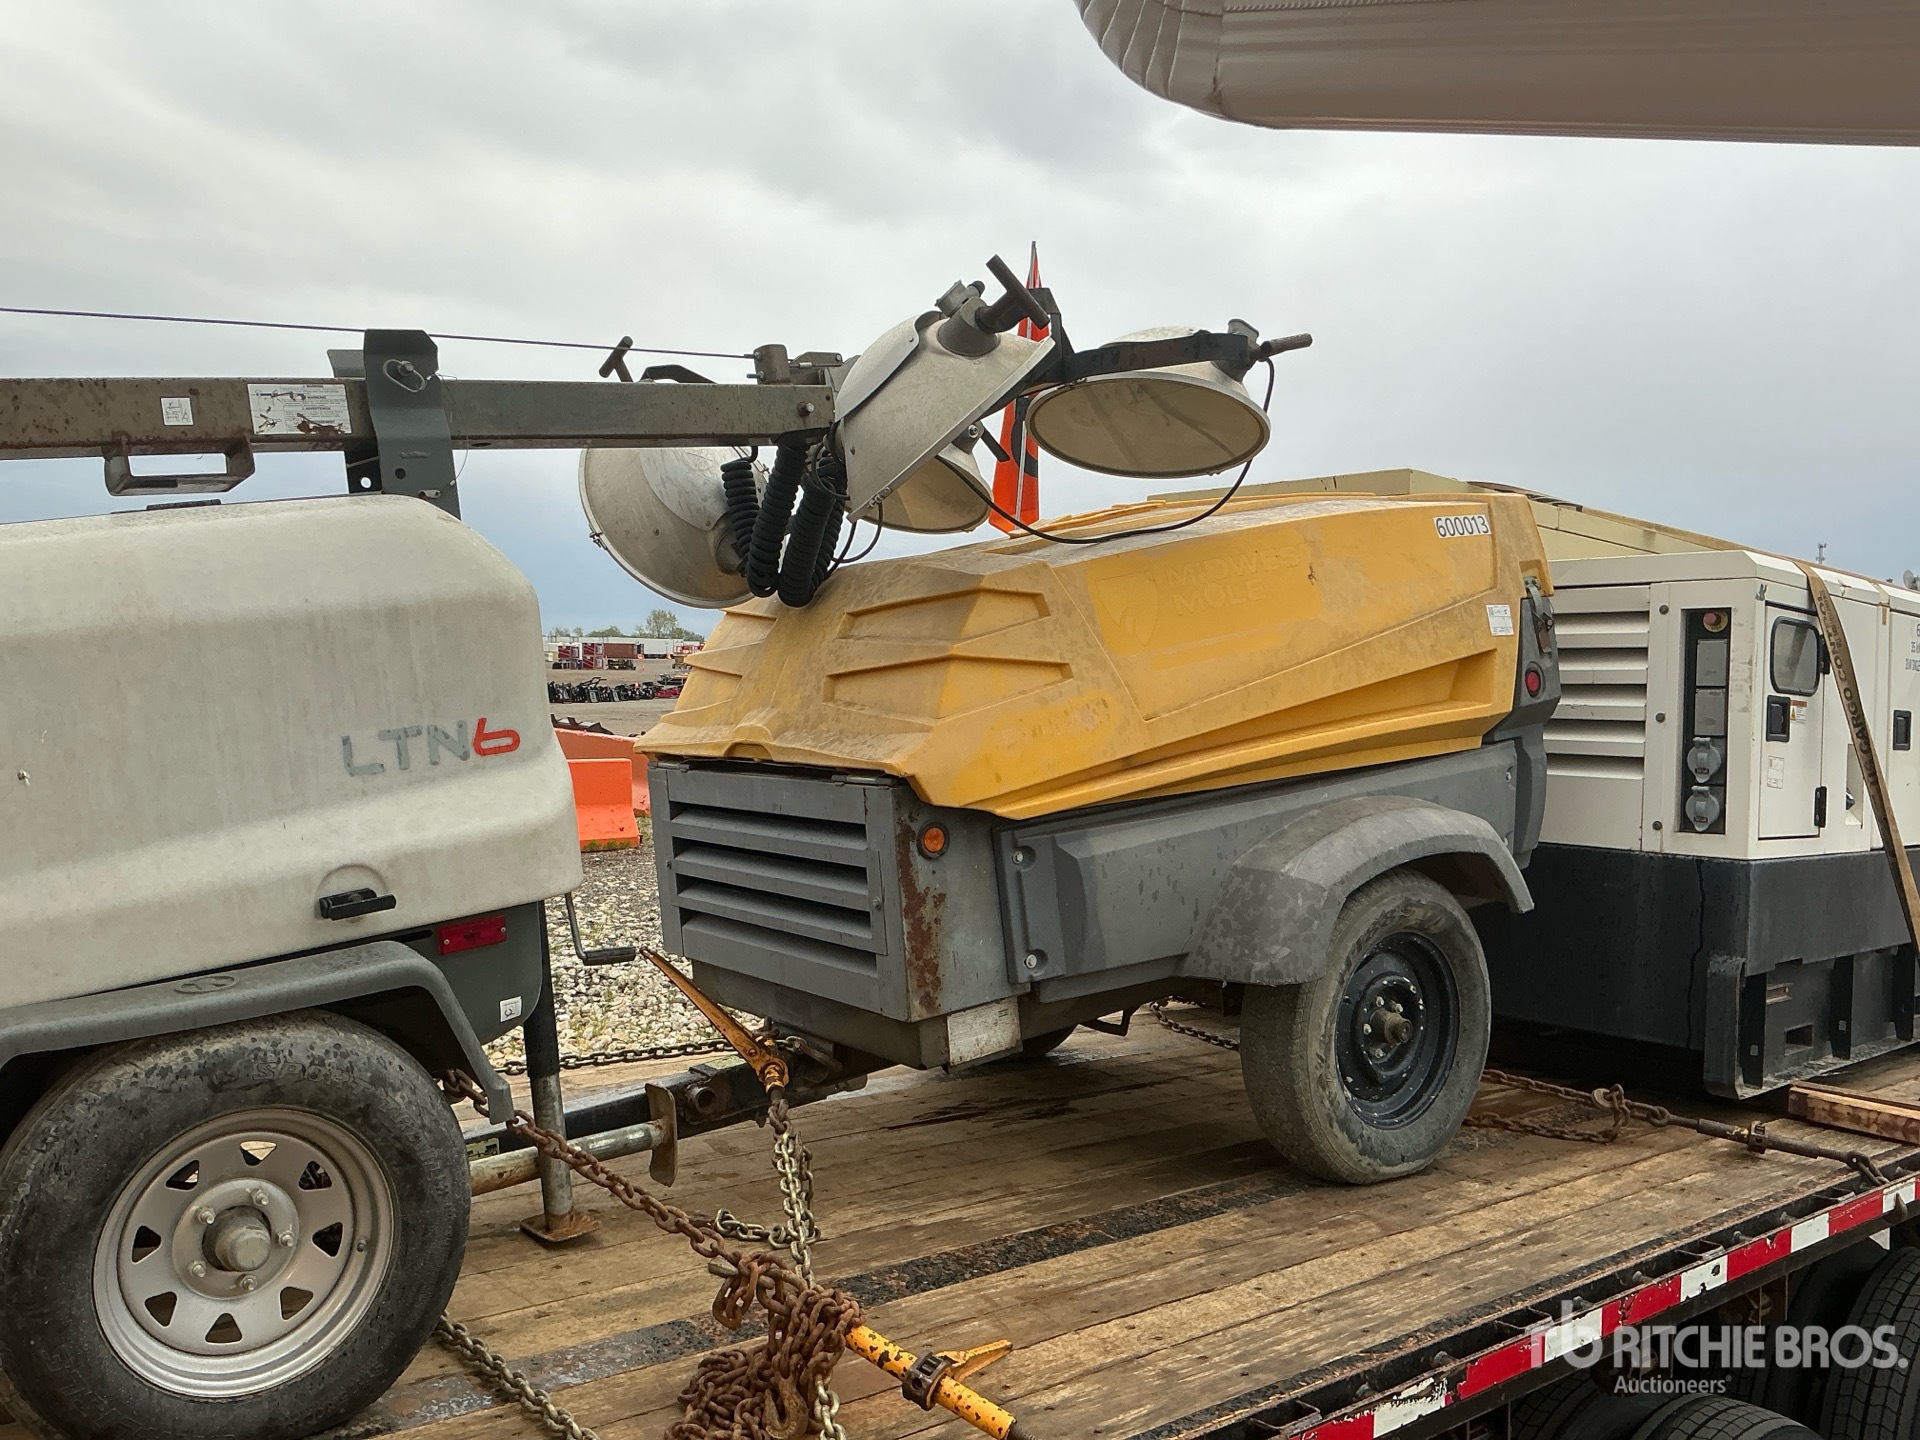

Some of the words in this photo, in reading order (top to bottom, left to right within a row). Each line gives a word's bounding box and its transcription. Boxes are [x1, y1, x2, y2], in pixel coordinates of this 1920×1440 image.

[1436, 515, 1489, 537] 600013
[1172, 577, 1267, 617] MOLE
[1843, 687, 1872, 755] CARGO
[341, 718, 520, 776] LTN6
